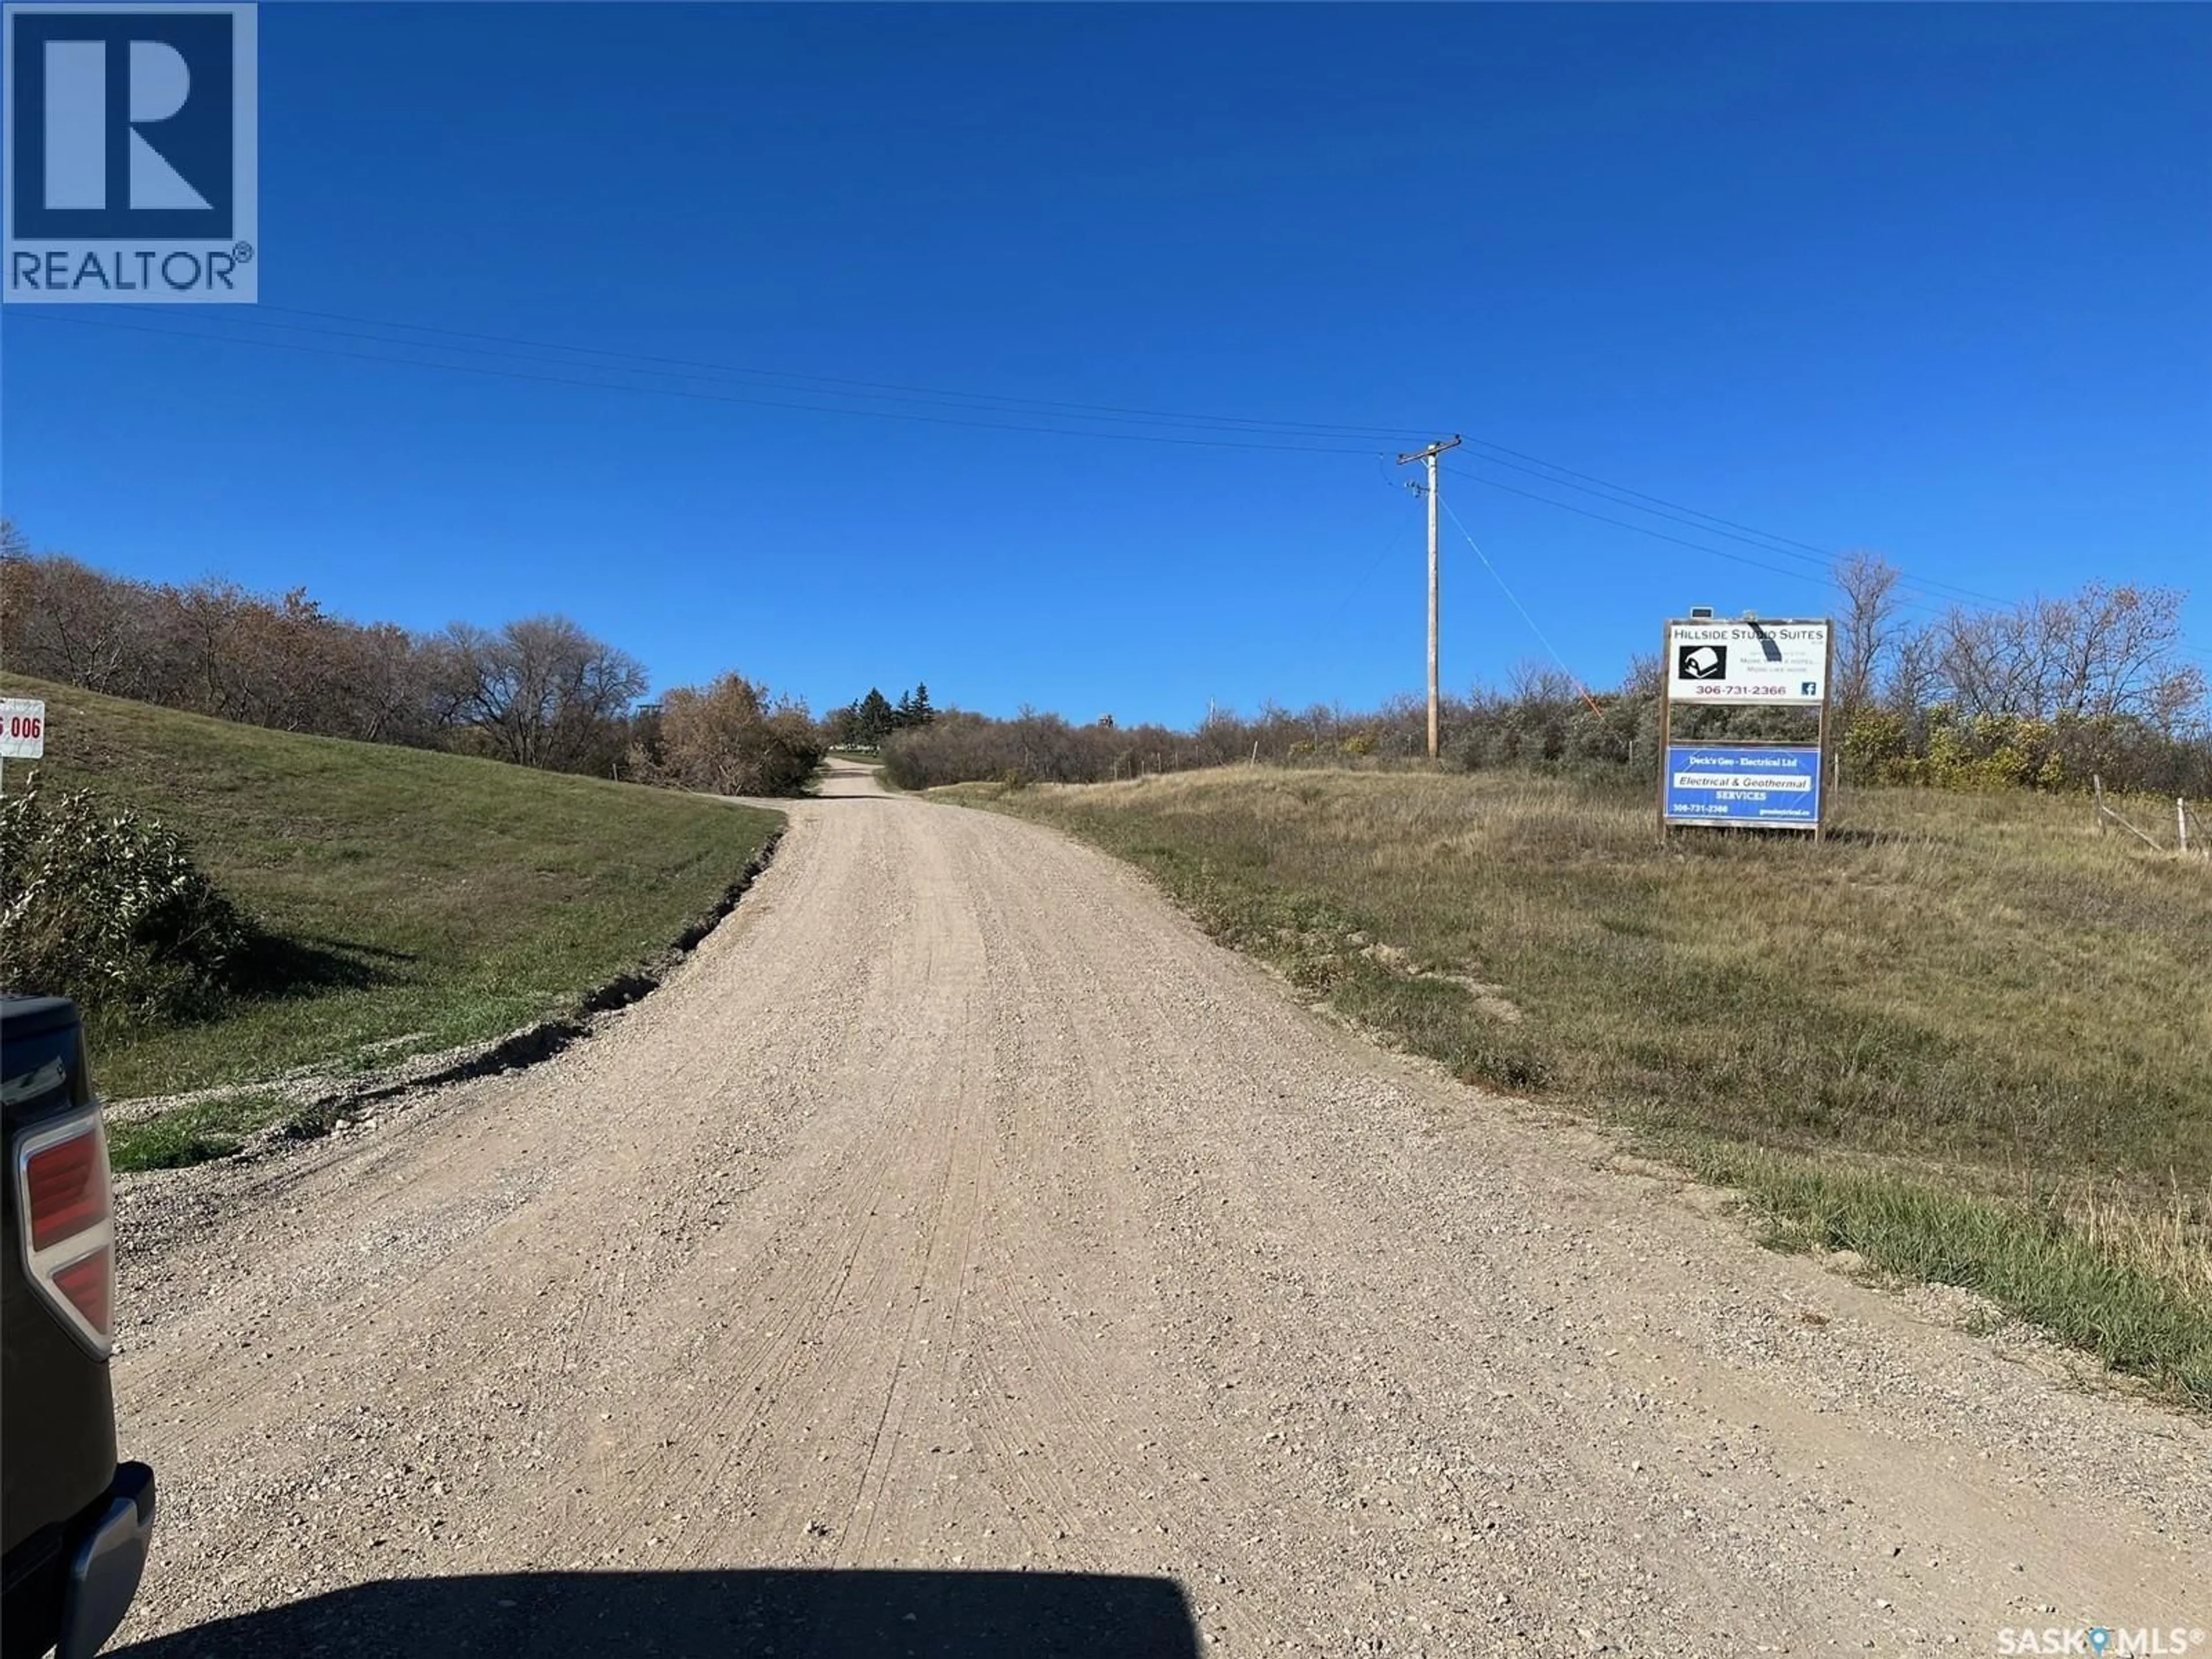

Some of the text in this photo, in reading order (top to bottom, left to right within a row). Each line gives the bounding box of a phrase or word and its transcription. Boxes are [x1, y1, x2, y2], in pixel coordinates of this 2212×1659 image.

[1675, 629, 1728, 639] HILLSIDE
[1779, 629, 1823, 639] SUITES
[1696, 685, 1786, 695] 306-731-2366
[12, 717, 40, 738] 006
[1740, 757, 1780, 766] Electrical
[1680, 776, 1806, 789] Electrical & Geothermal
[1715, 790, 1767, 801] SERVICES
